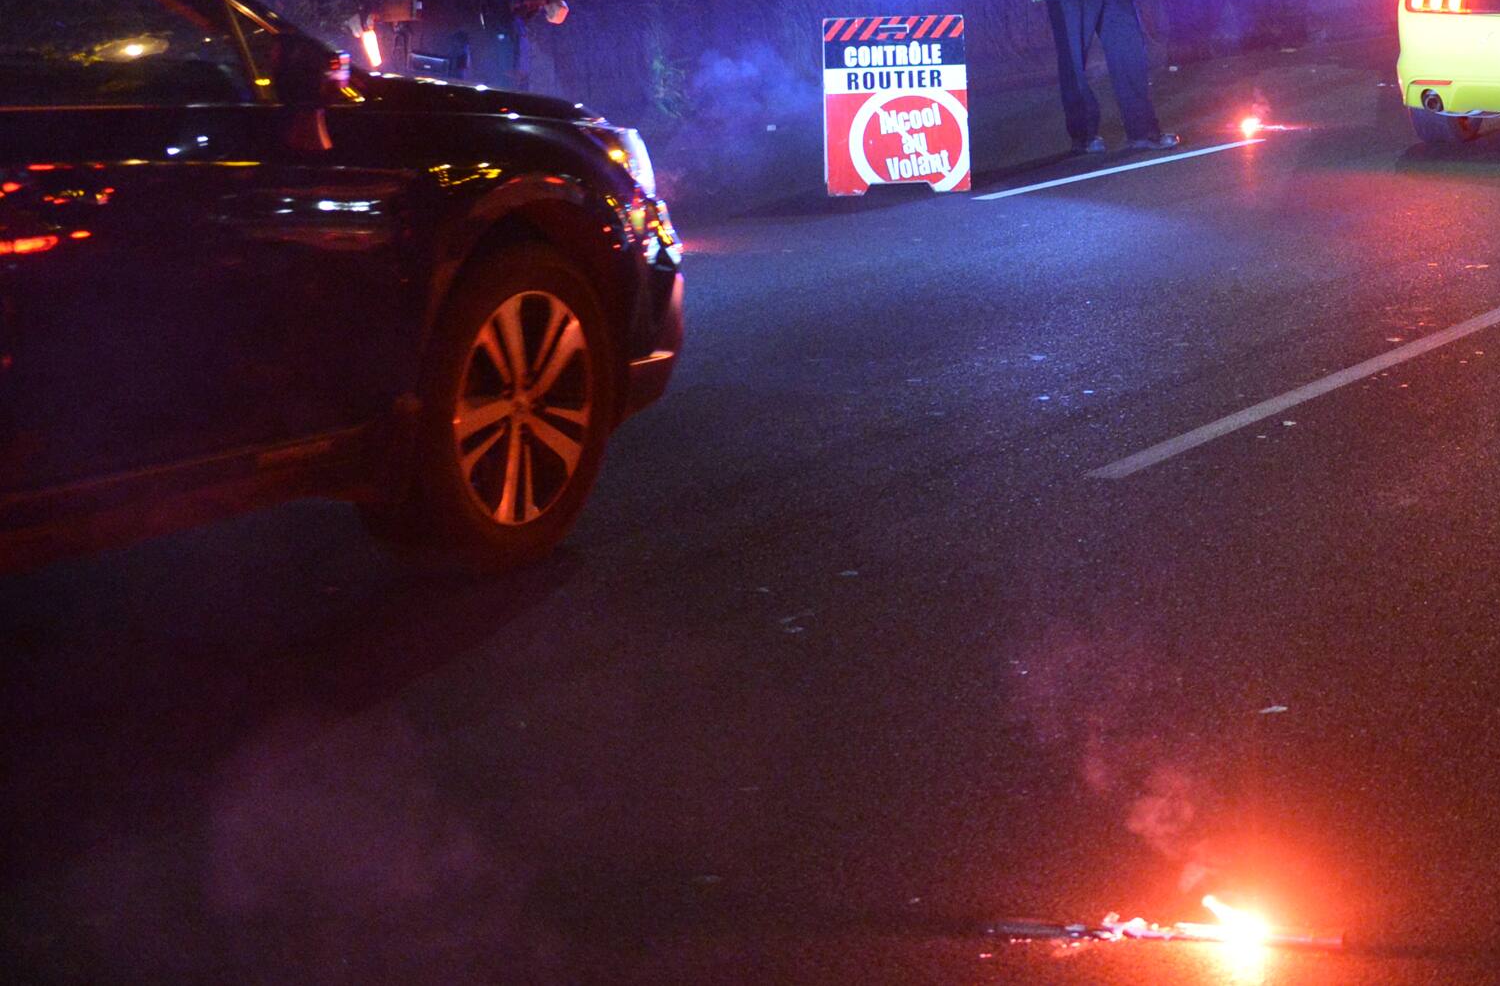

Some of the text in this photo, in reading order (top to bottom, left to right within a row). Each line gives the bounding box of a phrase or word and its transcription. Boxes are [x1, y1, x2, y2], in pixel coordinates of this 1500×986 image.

[844, 41, 942, 67] CONTRÔLE
[847, 69, 942, 91] ROUTIER
[886, 149, 951, 181] Volant
